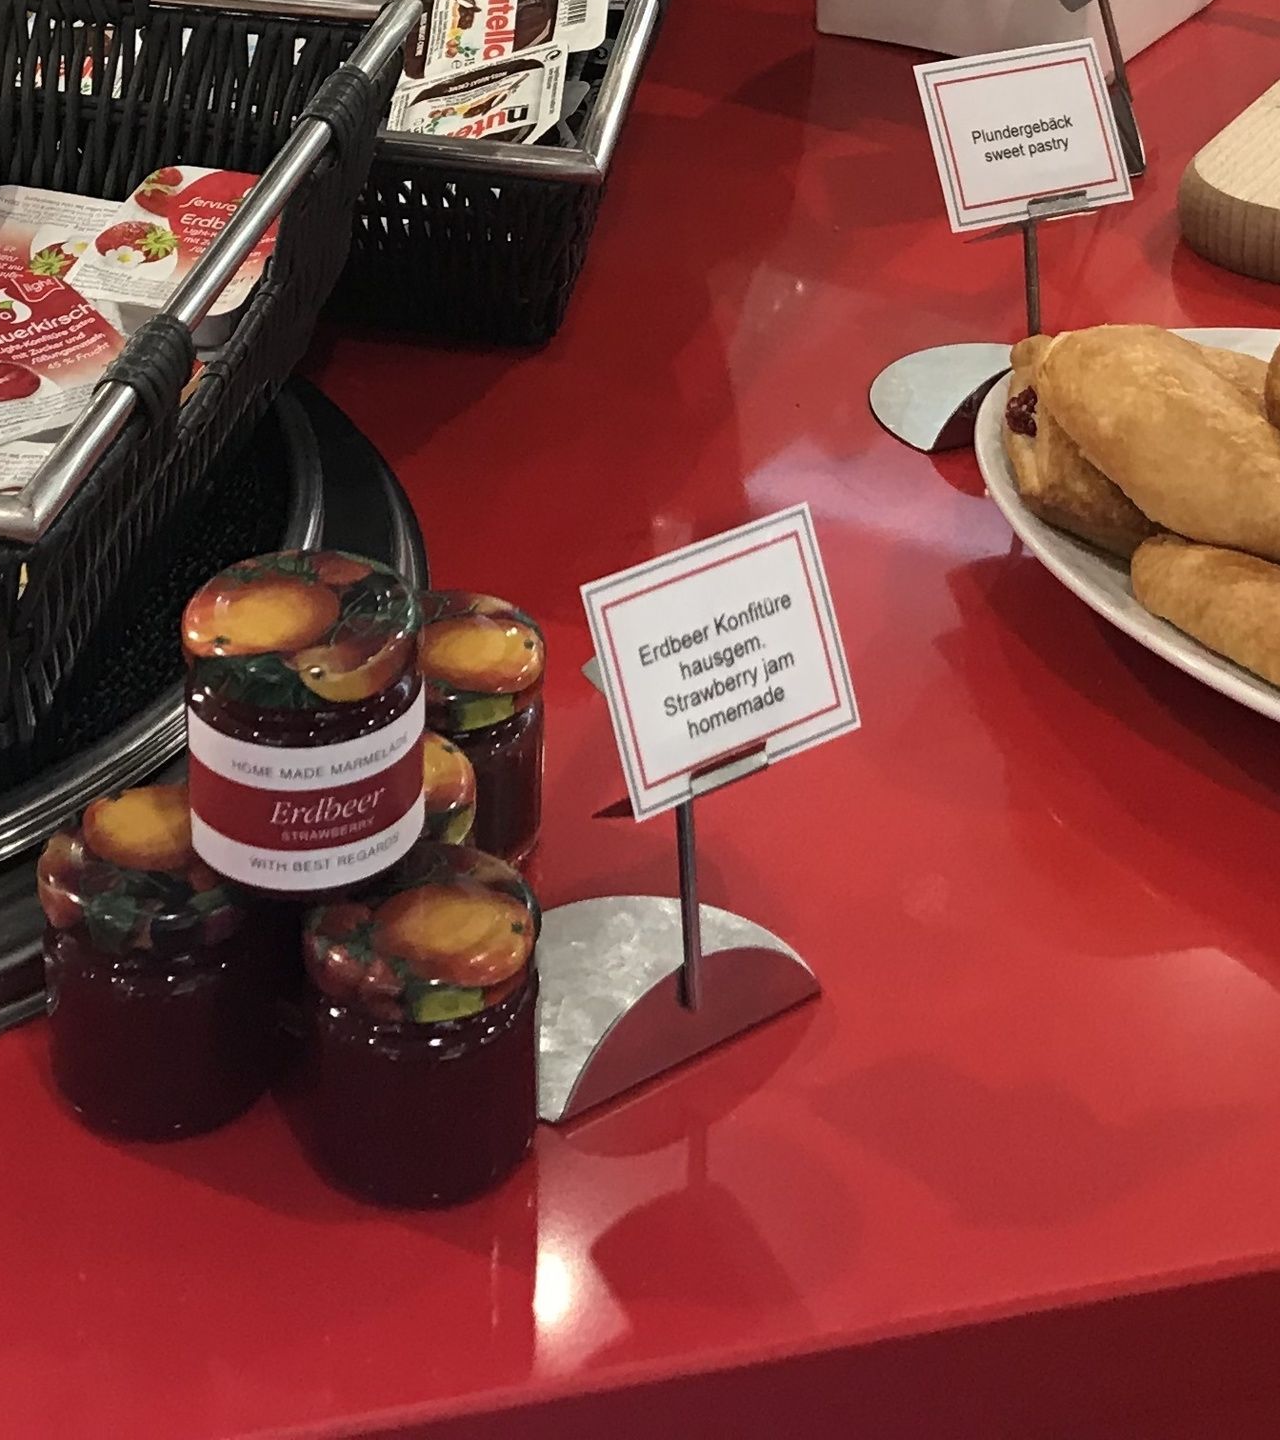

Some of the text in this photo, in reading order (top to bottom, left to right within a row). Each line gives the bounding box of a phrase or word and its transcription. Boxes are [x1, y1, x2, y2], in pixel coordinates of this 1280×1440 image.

[447, 104, 529, 139] nute
[971, 114, 1073, 145] Plundergebäck
[984, 137, 1069, 162] sweet pastry
[179, 212, 226, 230] Erdb
[23, 277, 56, 294] light
[70, 316, 97, 333] Extra
[11, 331, 87, 362] mit Zucker und
[76, 341, 111, 362] Frucht
[638, 593, 792, 667] Erdbeer Konfitüre
[679, 634, 767, 680] hausgem.
[663, 651, 795, 717] Strawberry jam
[686, 685, 786, 739] homemade
[231, 759, 274, 779] HOME
[279, 766, 325, 780] MADE
[269, 786, 386, 825] Erdbeer
[280, 815, 376, 842] STRAWBERRY
[248, 830, 400, 873] WITH BEST REGARDS
